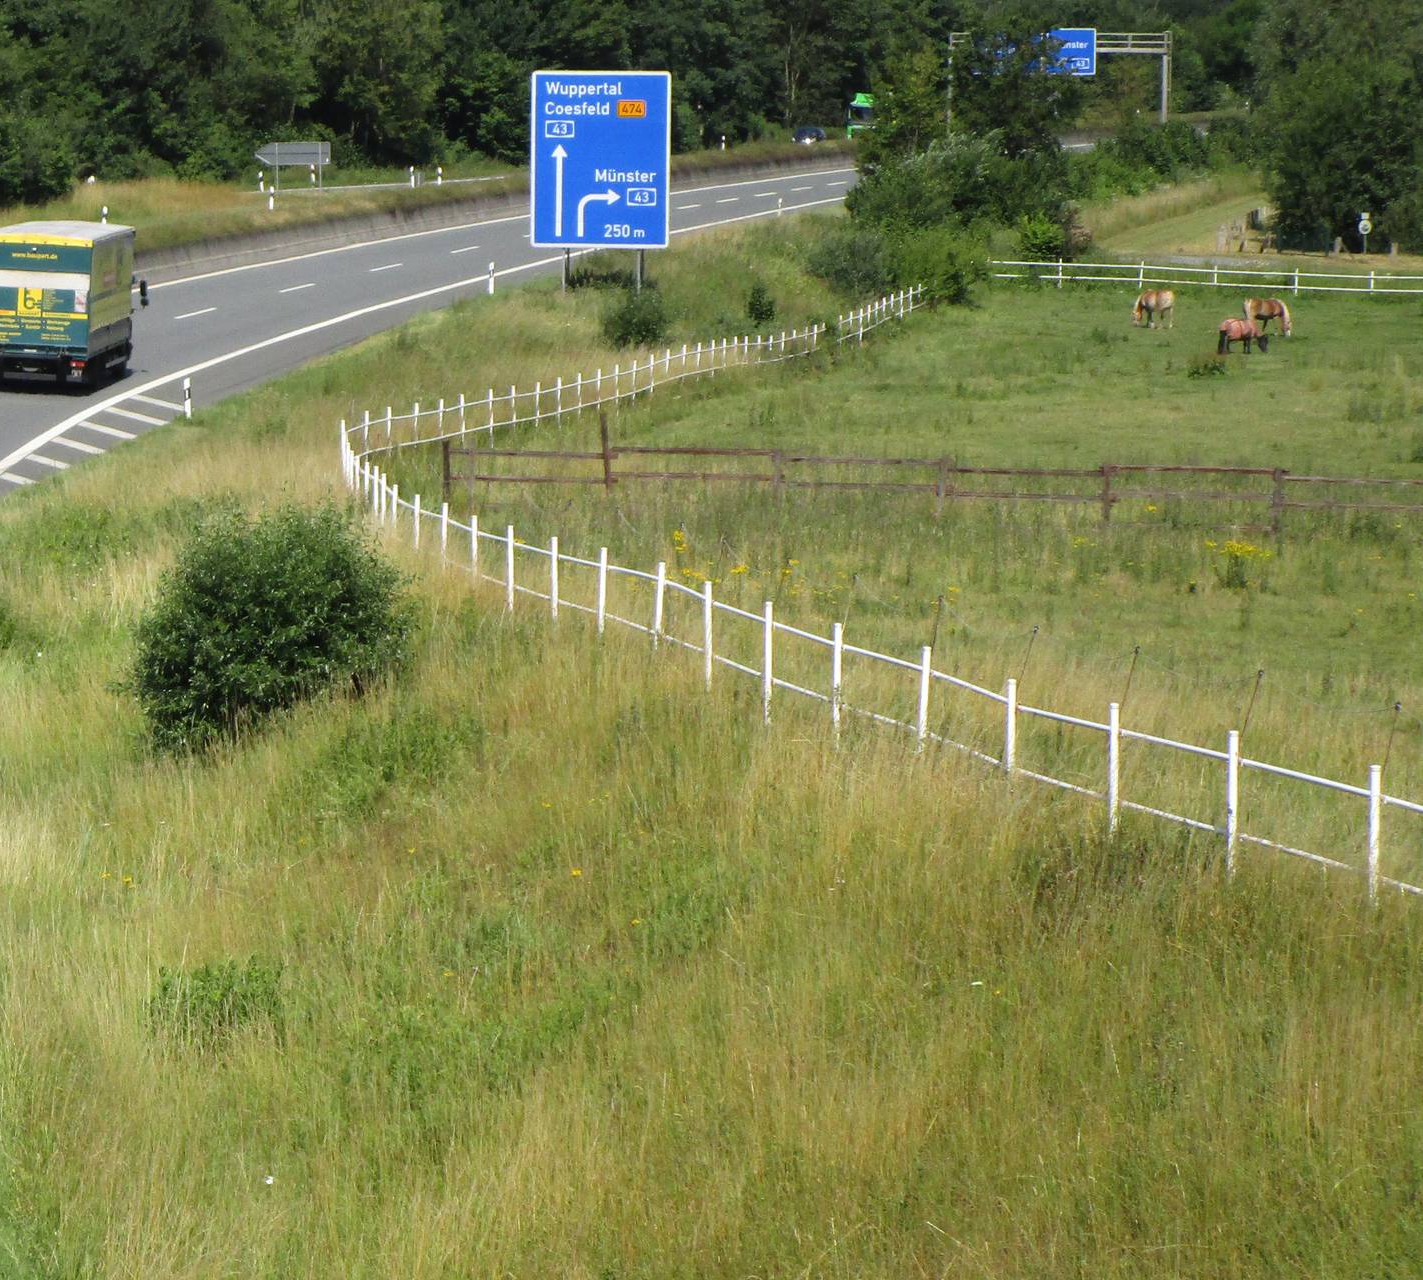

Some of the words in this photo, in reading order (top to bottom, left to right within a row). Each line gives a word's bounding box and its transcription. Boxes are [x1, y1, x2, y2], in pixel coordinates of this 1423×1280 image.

[545, 82, 622, 98] Wuppertal
[545, 102, 610, 115] Coesfeld
[621, 103, 642, 114] 474
[552, 124, 568, 135] 43
[595, 169, 656, 183] Münster
[634, 192, 650, 203] 43
[604, 224, 630, 238] 250
[634, 229, 645, 238] m
